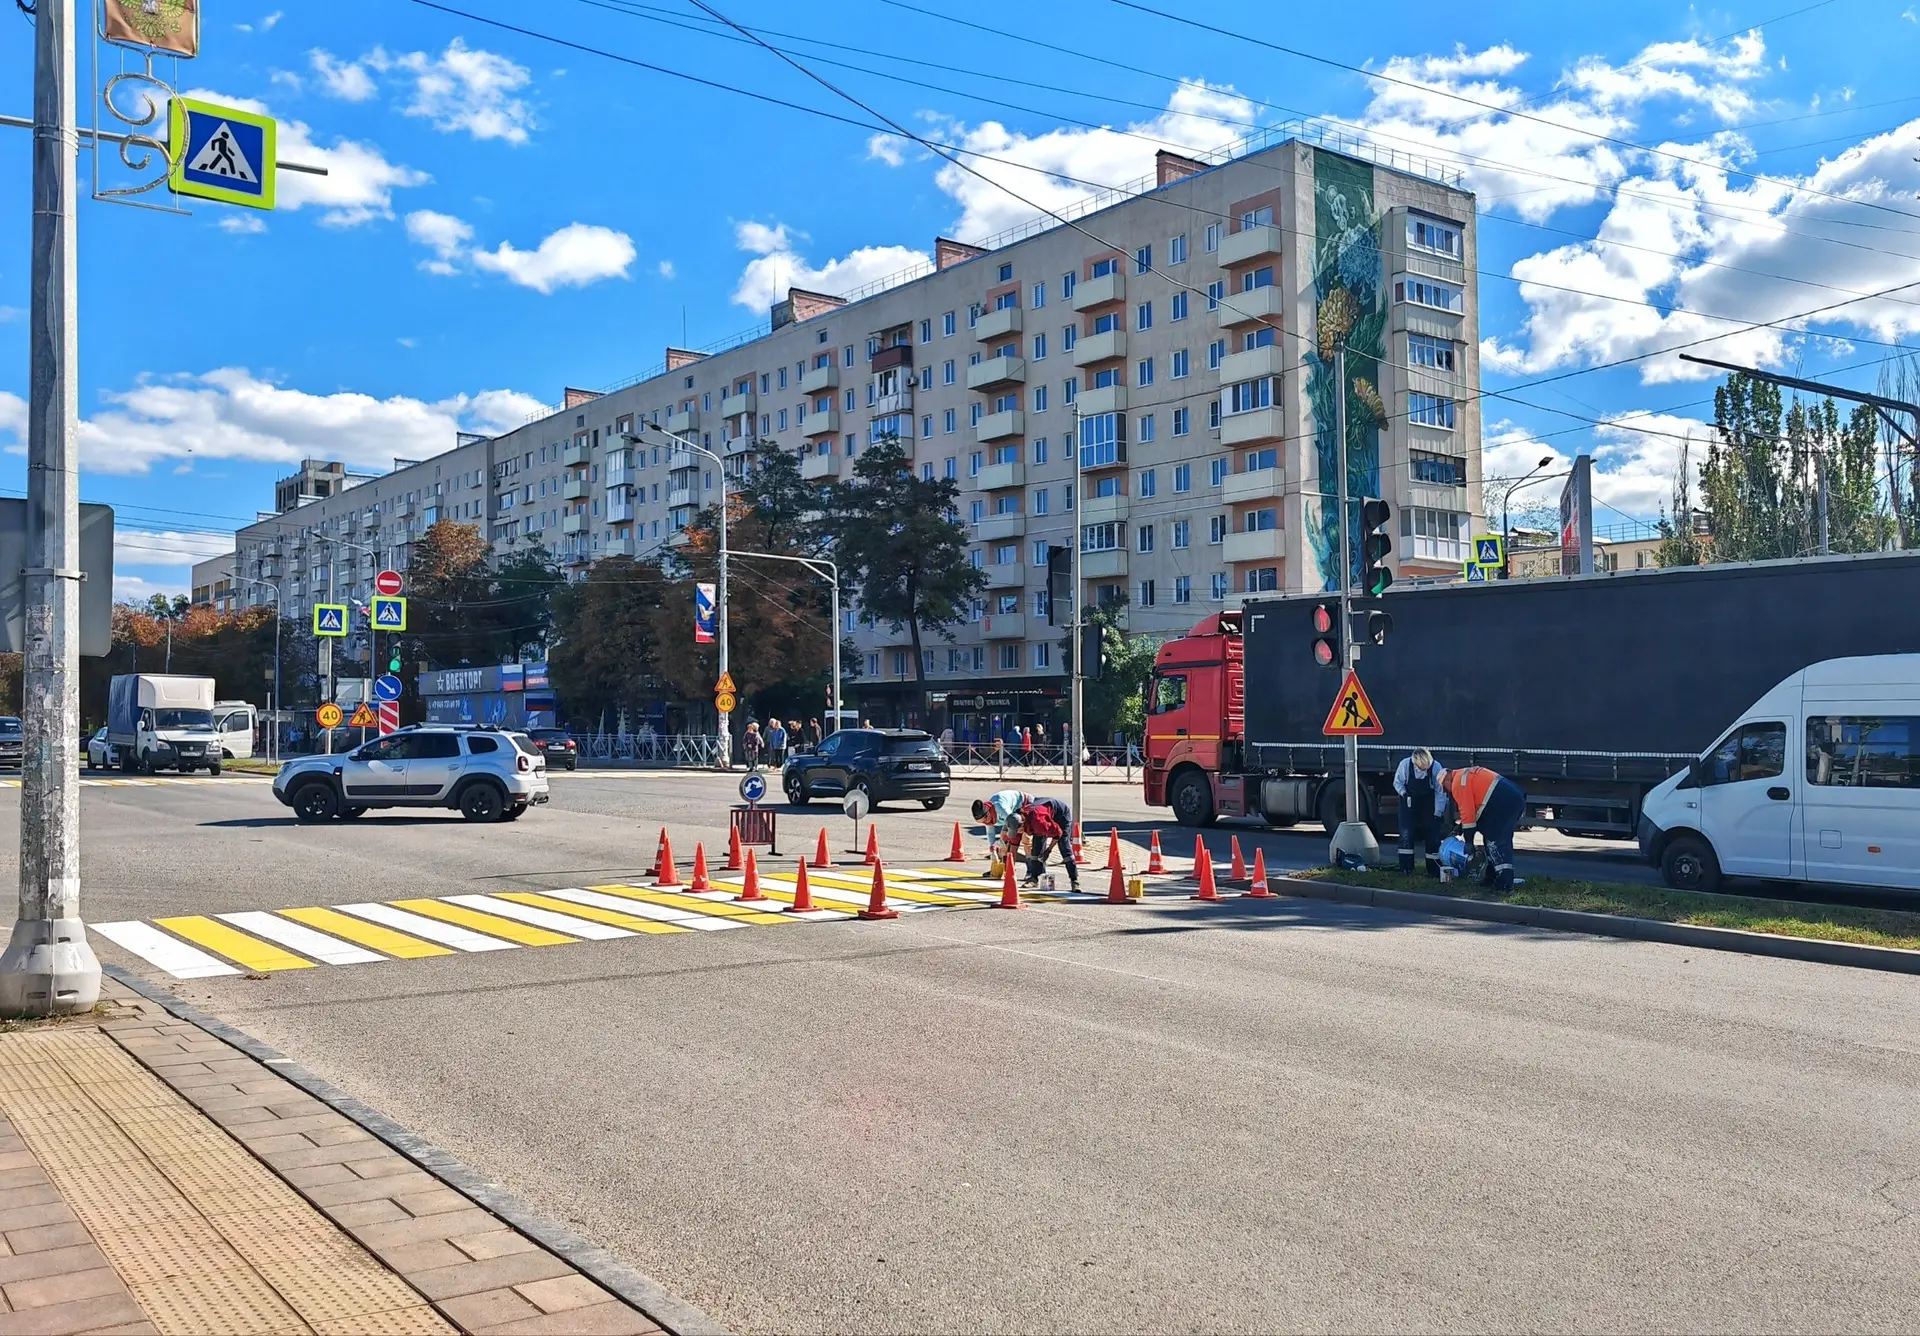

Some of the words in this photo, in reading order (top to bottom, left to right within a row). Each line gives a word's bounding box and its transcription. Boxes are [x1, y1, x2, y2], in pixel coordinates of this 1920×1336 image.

[445, 670, 483, 691] ВОЕНТОРГ
[720, 698, 732, 706] 40
[322, 710, 338, 720] 40
